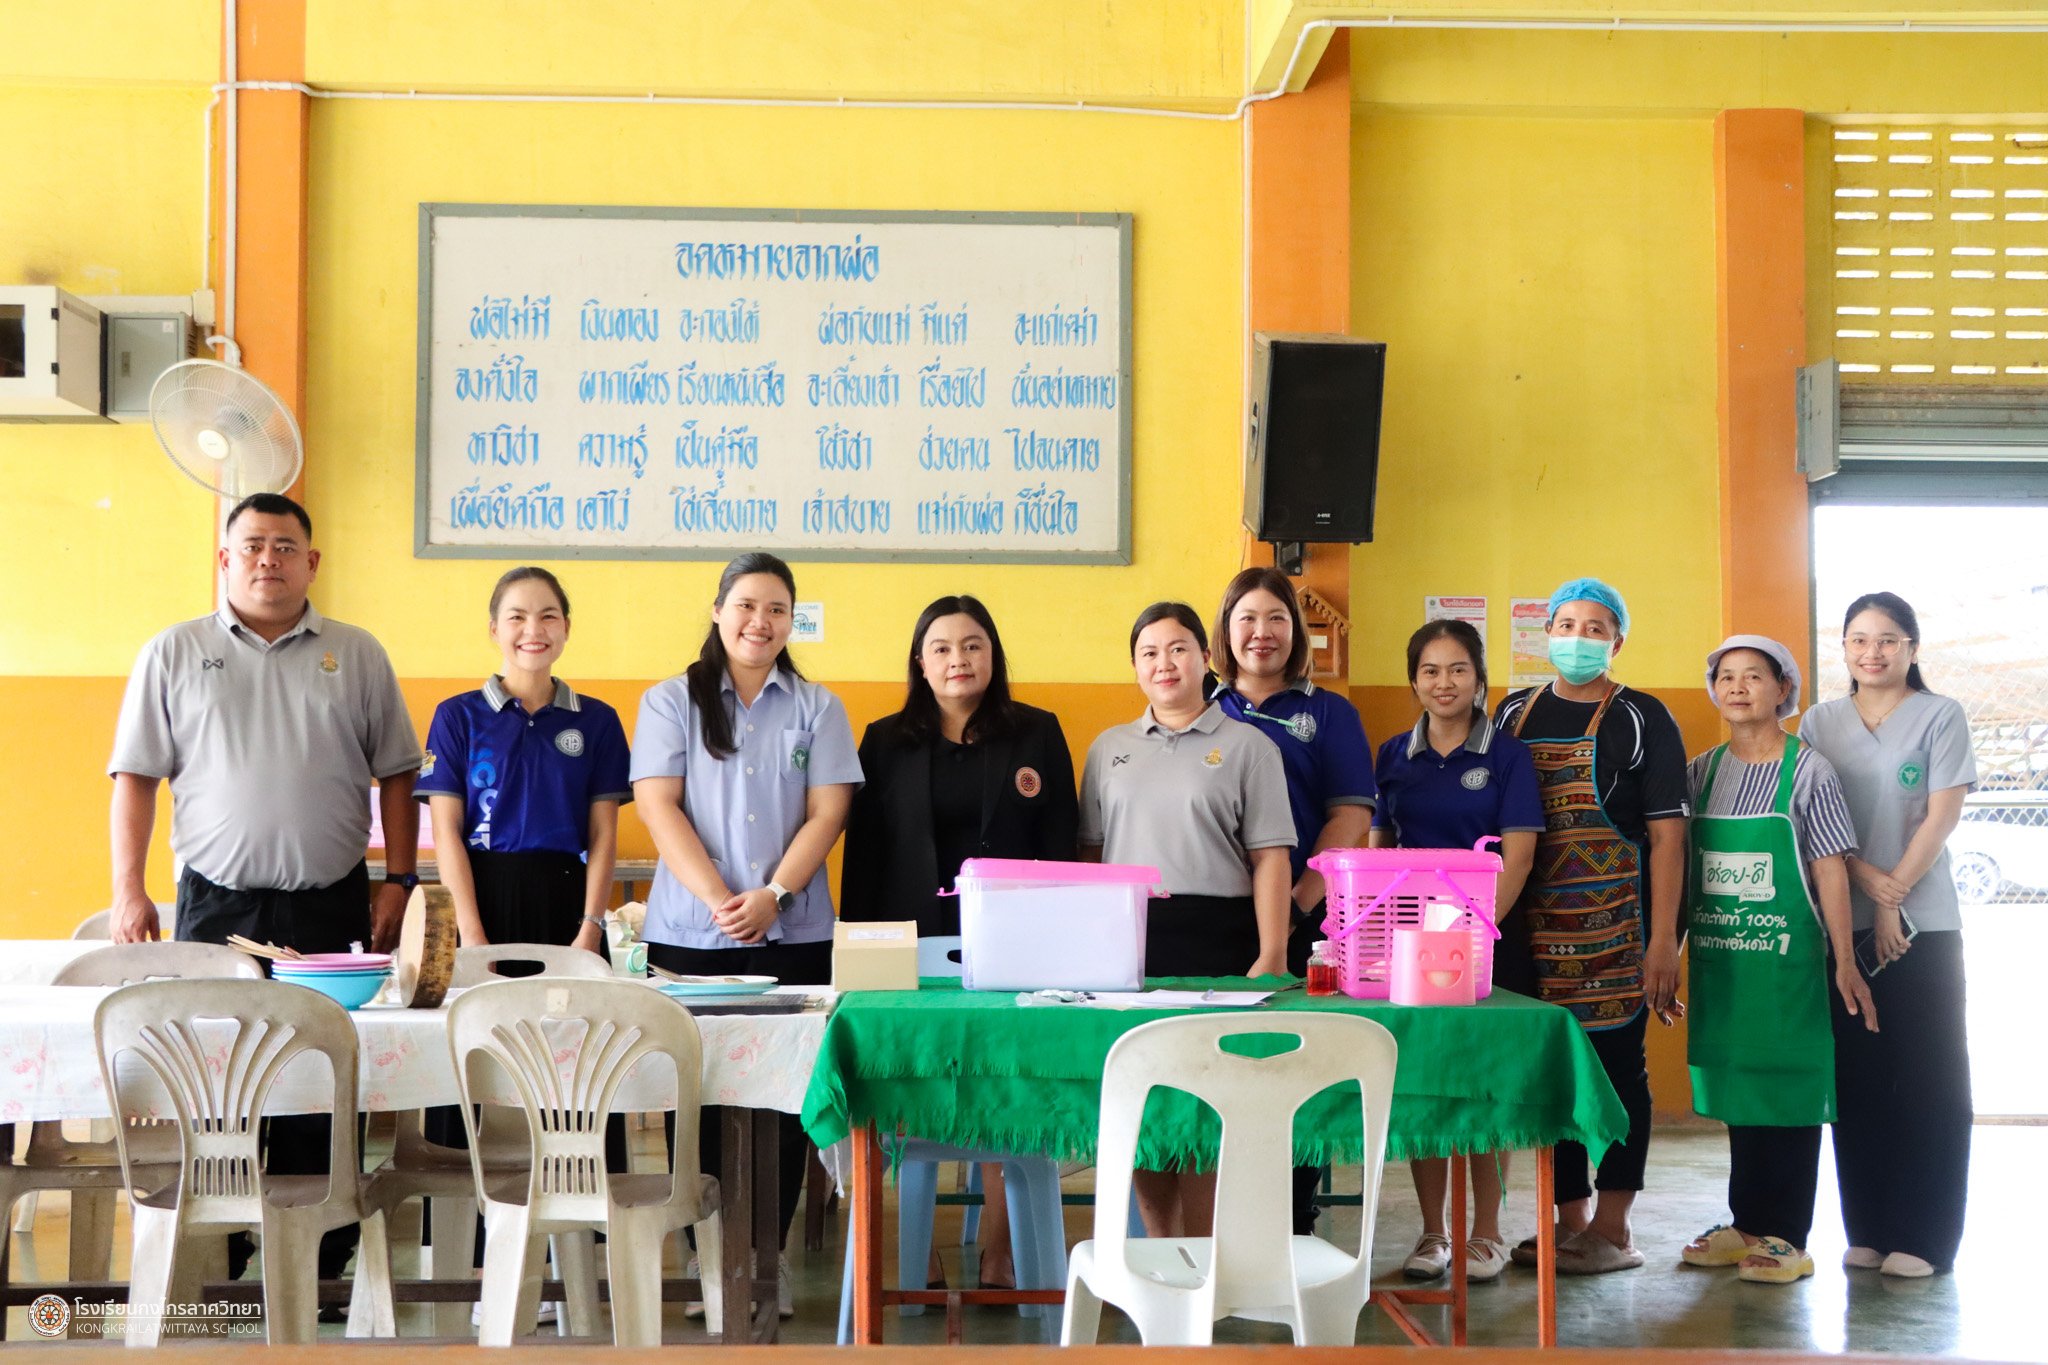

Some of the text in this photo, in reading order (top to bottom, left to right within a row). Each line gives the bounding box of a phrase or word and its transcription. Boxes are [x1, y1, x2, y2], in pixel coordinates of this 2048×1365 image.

[676, 234, 880, 283] จดหมายจากพ่อ
[470, 295, 759, 343] พ่อไม่มี เงินทอง จะกองให้
[919, 301, 968, 345] มีแต่
[1015, 304, 1098, 345] จะแก่เฒ่า
[579, 360, 671, 405] พากเพียร
[808, 356, 1116, 410] จะเลี้ยงเจ้า เรื่อยไป นั้นอย่าหมาย
[468, 420, 758, 480] หาวิชา ความรู้ เป็นคู่มือ
[816, 422, 872, 470] ใช้วิชา
[1004, 428, 1100, 472] ไปจนตาย
[669, 479, 777, 533] ใช้เลี้ยงกาย
[803, 482, 1078, 535] เจ้าสบาย แม่กับพ่อ ก็ชื่นใจ
[1707, 860, 1768, 884] อร่อย-ดี
[1746, 913, 1788, 929] 100%
[1777, 933, 1791, 956] 1
